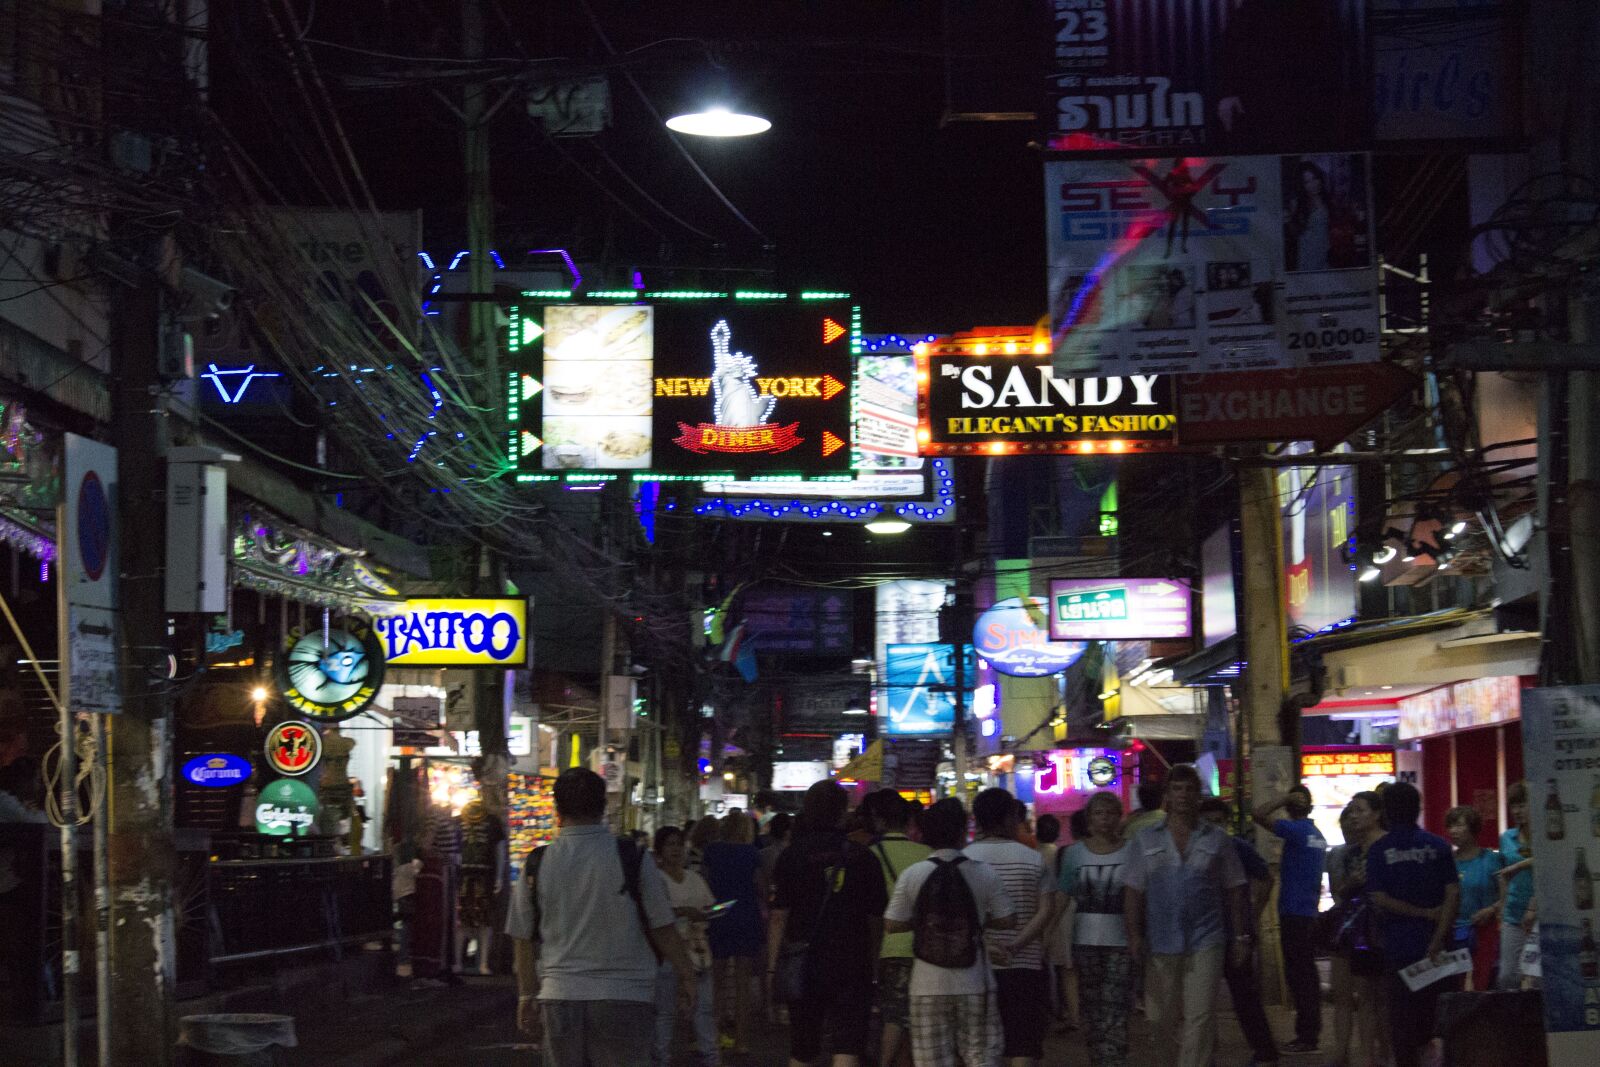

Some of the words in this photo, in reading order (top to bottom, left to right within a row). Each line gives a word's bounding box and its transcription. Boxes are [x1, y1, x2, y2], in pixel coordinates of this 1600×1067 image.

[1054, 10, 1108, 42] 23
[654, 378, 711, 397] NEW
[758, 377, 822, 397] YORK
[960, 364, 1159, 409] SANDY
[1182, 383, 1367, 423] EXCHANGE
[947, 413, 1078, 434] ELEGANT'S
[701, 428, 777, 447] DINER
[376, 611, 521, 662] TATTOO
[189, 766, 242, 783] Corona
